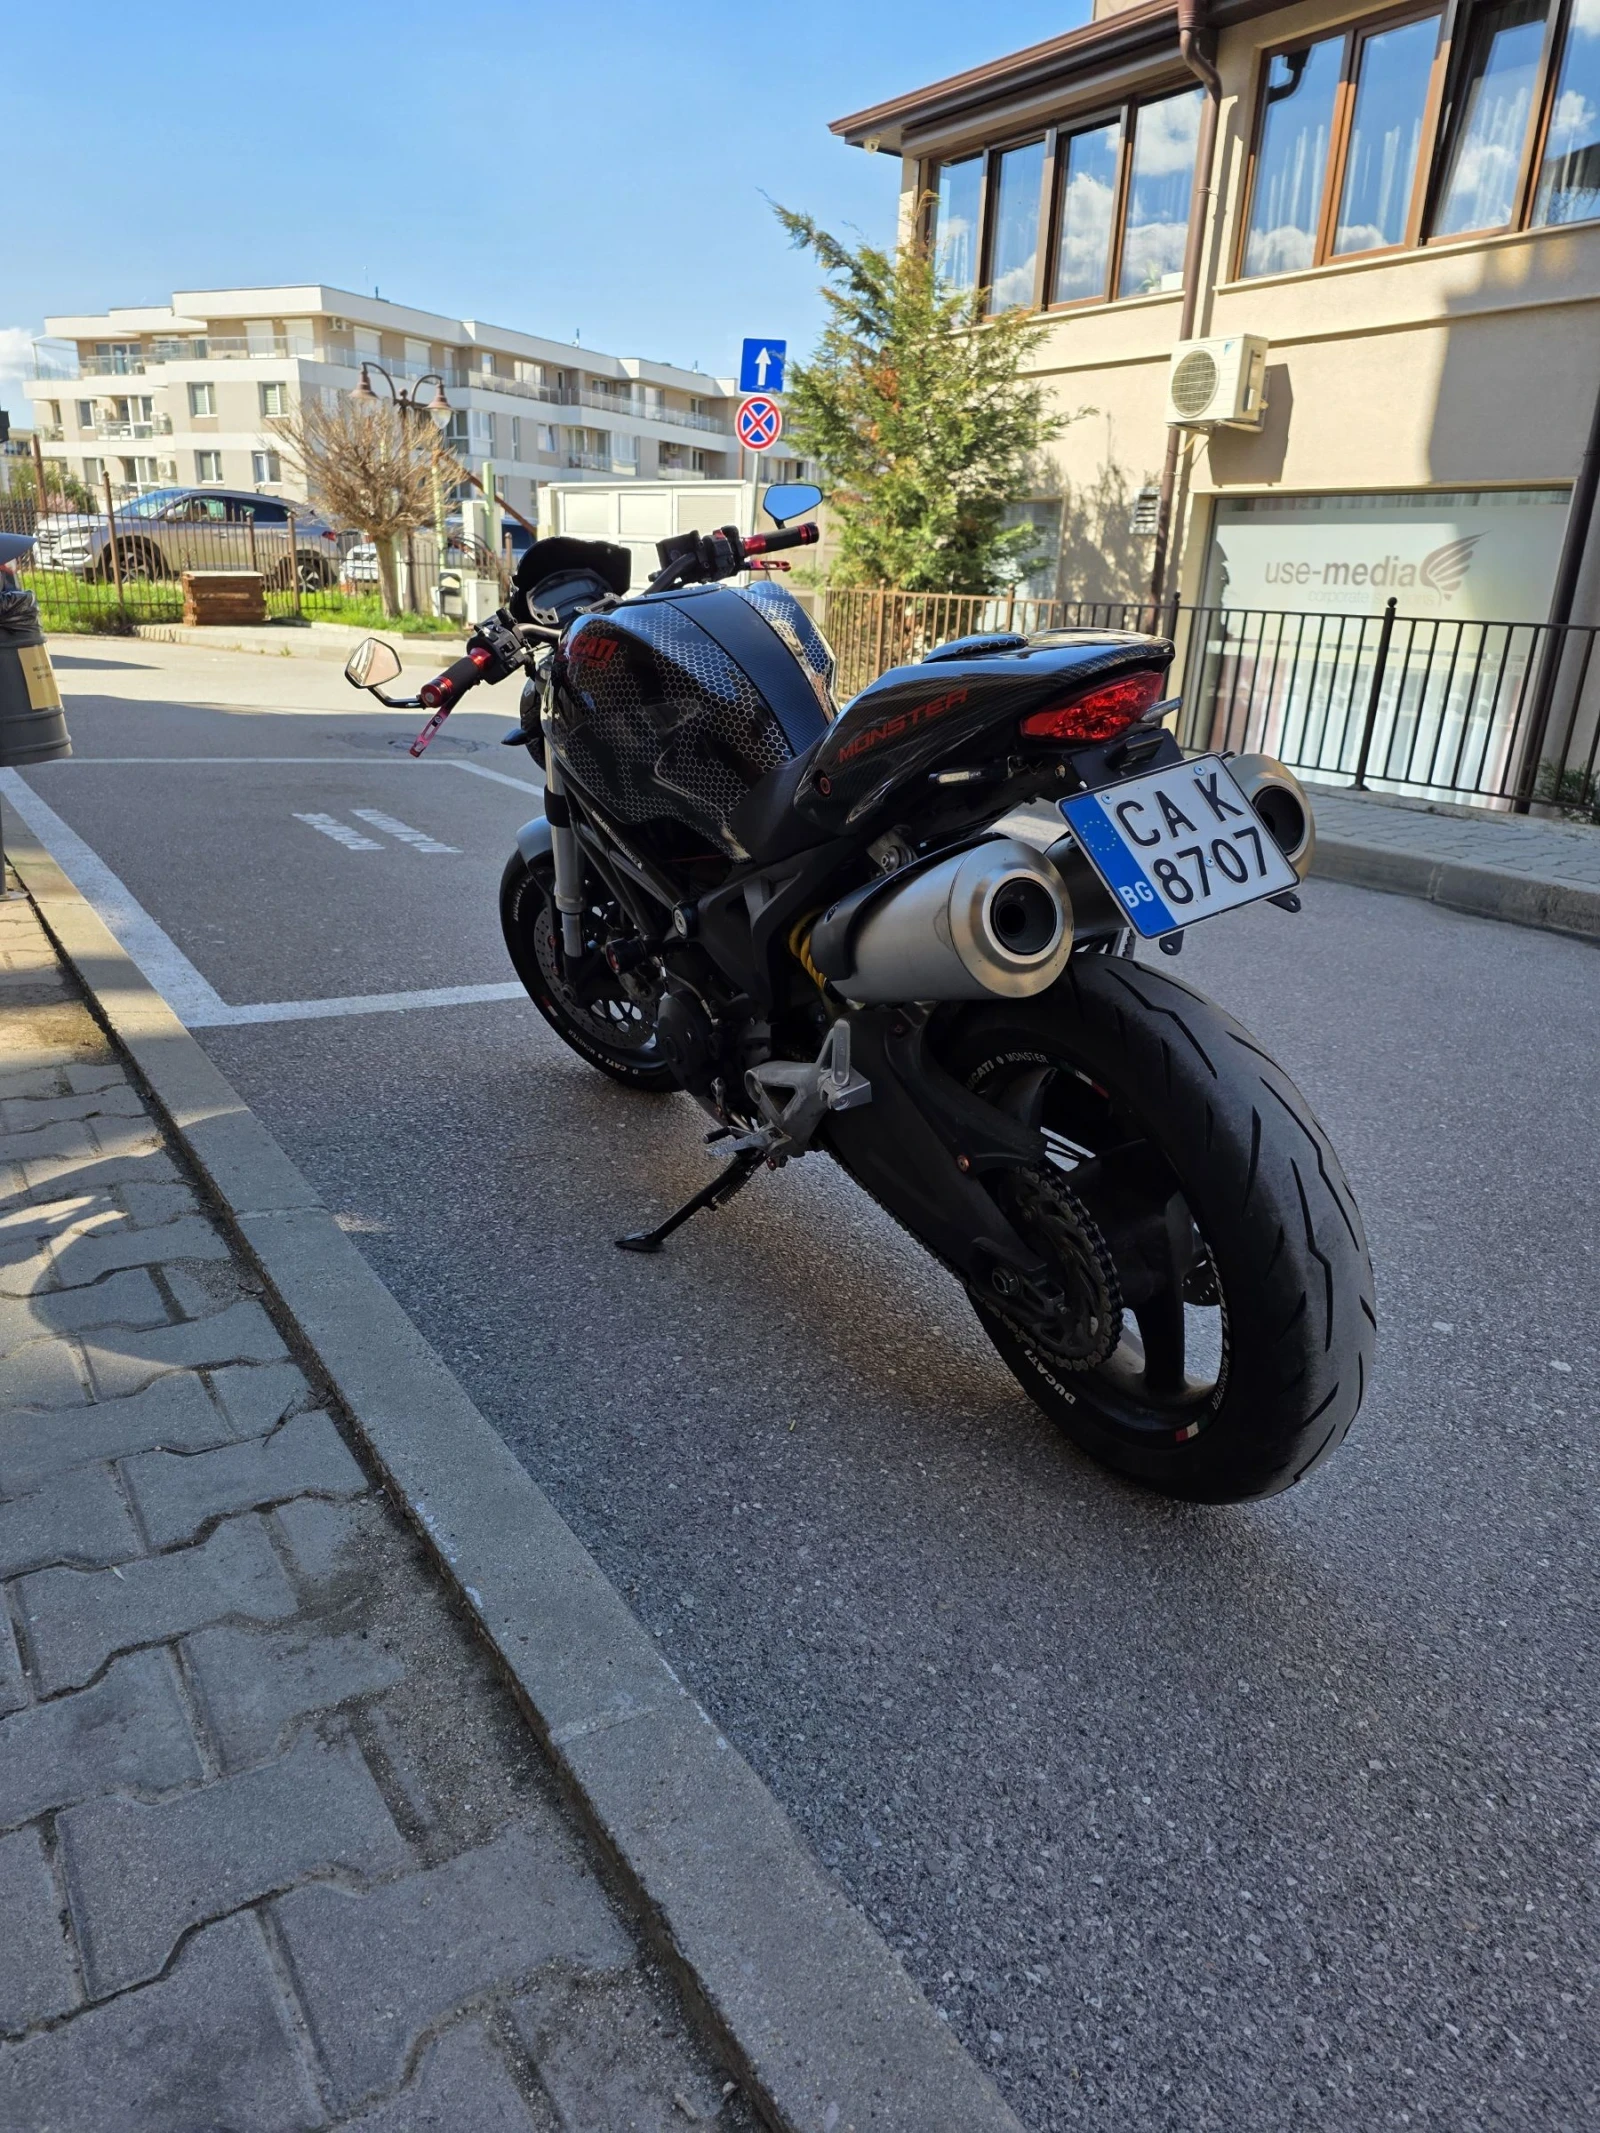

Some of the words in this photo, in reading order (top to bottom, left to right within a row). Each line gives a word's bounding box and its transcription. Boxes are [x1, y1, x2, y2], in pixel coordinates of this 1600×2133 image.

[1265, 555, 1417, 587] use-media
[1308, 590, 1369, 606] corporate
[839, 689, 968, 763] MONSTER
[1152, 826, 1268, 905] 8707
[1118, 881, 1155, 909] BG
[965, 1059, 995, 1091] UCATI
[1004, 1051, 1049, 1064] MONSTER
[1024, 1350, 1076, 1405] DUCATI
[1211, 1355, 1231, 1411] MONSTER
